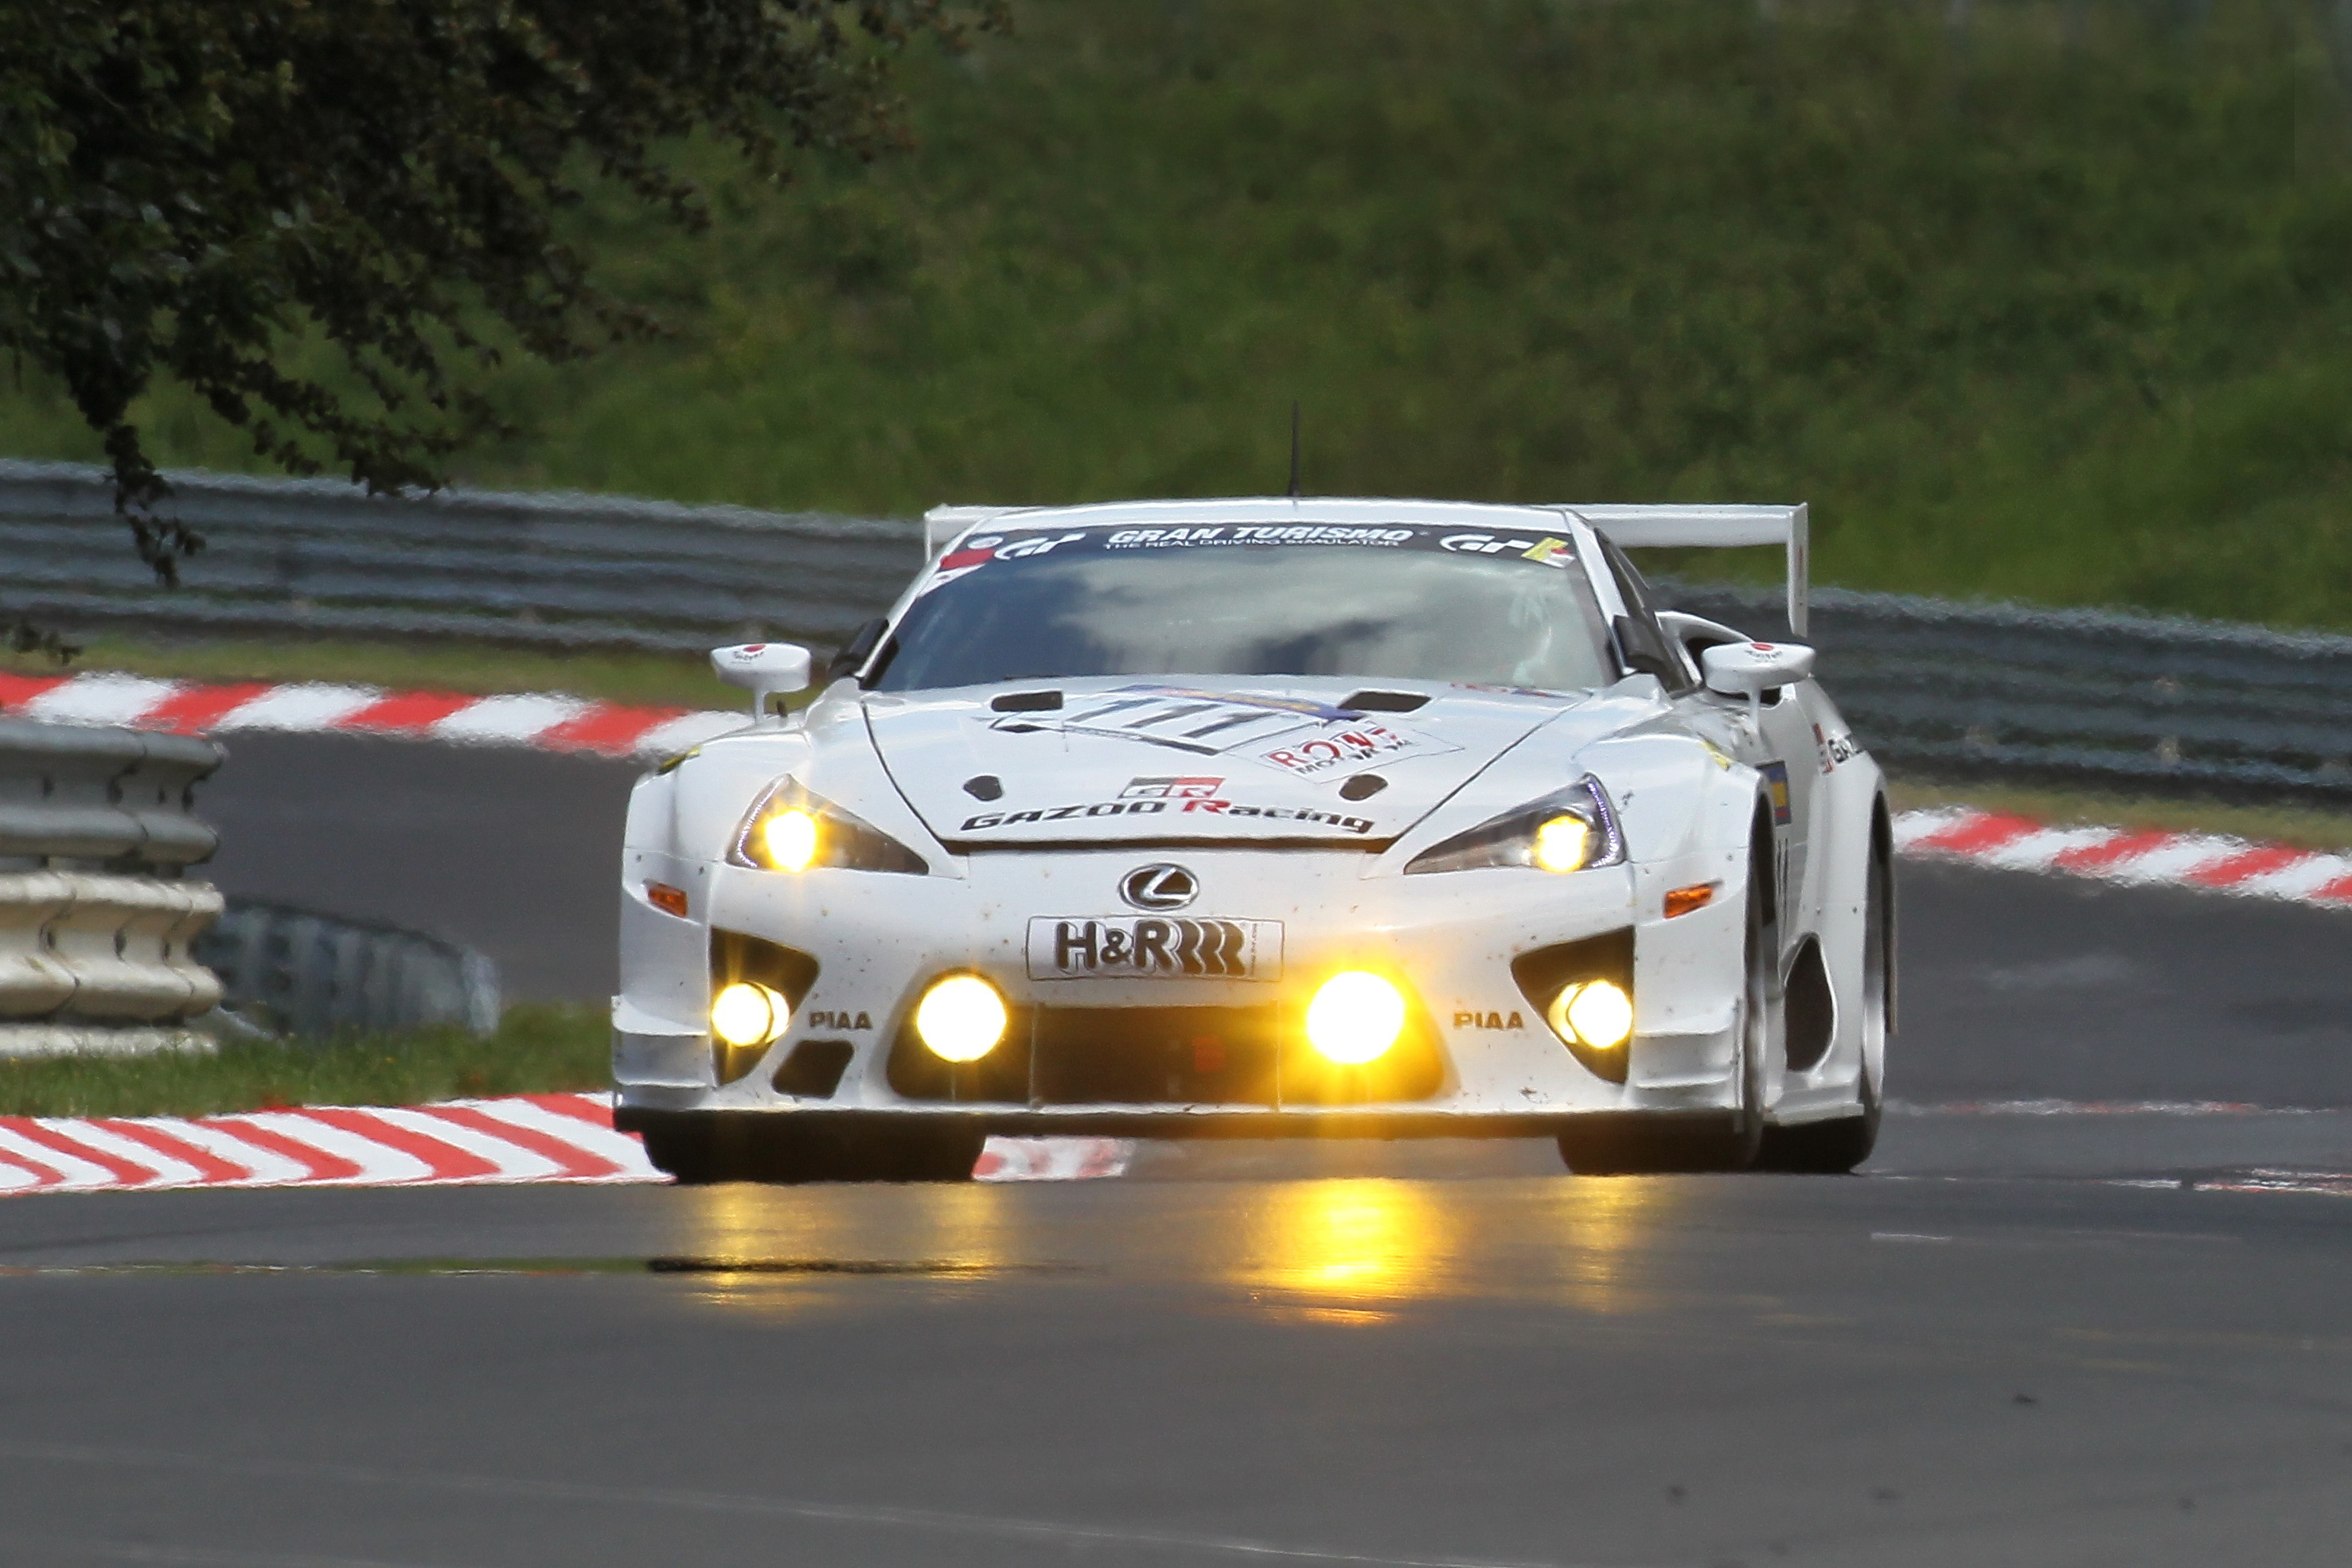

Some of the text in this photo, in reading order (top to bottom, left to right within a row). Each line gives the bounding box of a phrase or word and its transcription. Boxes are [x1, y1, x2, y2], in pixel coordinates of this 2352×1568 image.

[1108, 526, 1414, 544] GRAN TURISMO
[1285, 538, 1399, 547] SIMULATOR
[960, 799, 1375, 834] GAZOO Racing
[809, 1011, 874, 1029] PIAA
[1453, 1011, 1525, 1029] PIAA
